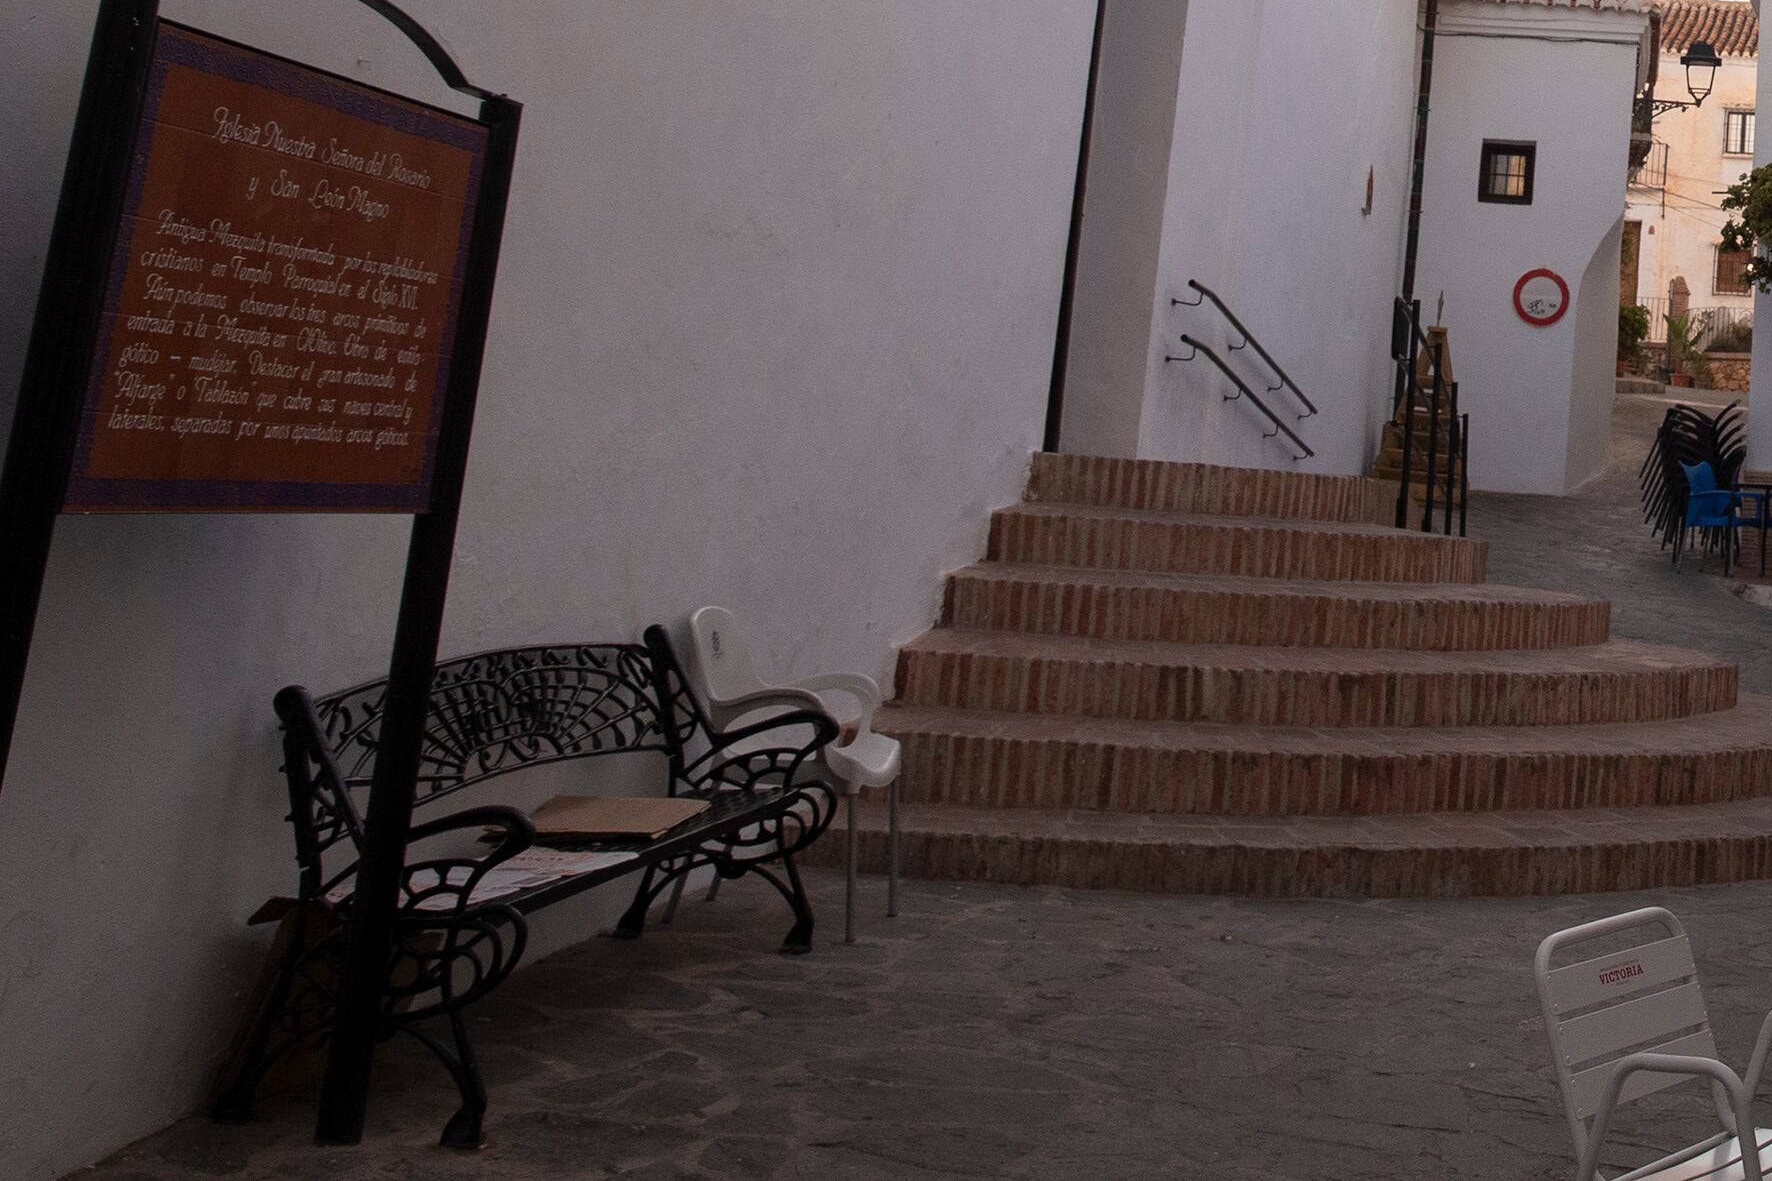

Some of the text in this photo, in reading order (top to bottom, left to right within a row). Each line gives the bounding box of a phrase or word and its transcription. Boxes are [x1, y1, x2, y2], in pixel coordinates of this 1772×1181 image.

[212, 106, 431, 188] Iglesia Nuestra Señora del Rosario
[246, 169, 390, 223] y San León Magno
[155, 209, 207, 245] Antigua
[208, 218, 266, 253] Mezquita
[266, 235, 335, 265] transformada
[338, 257, 362, 276] por
[140, 247, 204, 272] cristianos
[211, 262, 228, 277] en
[230, 255, 273, 289] Templo
[283, 263, 340, 298] Parroquial
[338, 283, 352, 297] en
[357, 279, 371, 300] el
[372, 279, 399, 310] Siglo
[143, 273, 174, 300] Aún
[171, 283, 228, 313] podemos
[239, 291, 289, 318] observar
[289, 297, 305, 321] los
[306, 303, 326, 323] tres
[332, 312, 360, 328] arcos
[414, 318, 427, 339] de
[127, 310, 175, 335] entrada
[182, 322, 193, 337] a
[194, 313, 208, 338] la
[215, 314, 271, 349] Mezquita
[272, 334, 288, 348] en
[373, 340, 388, 361] de
[118, 342, 159, 368] gótico
[248, 350, 301, 379] Destacar
[301, 361, 315, 381] el
[316, 369, 343, 388] gran
[404, 370, 417, 393] de
[170, 411, 233, 439] separadas
[235, 420, 261, 441] por
[263, 424, 290, 440] unos
[345, 428, 374, 443] arcos
[176, 385, 186, 400] o
[256, 391, 278, 412] que
[283, 387, 313, 411] cubre
[317, 398, 337, 414] sus
[372, 398, 408, 419] central
[403, 406, 414, 426] y
[1599, 964, 1644, 985] VICTORIA
